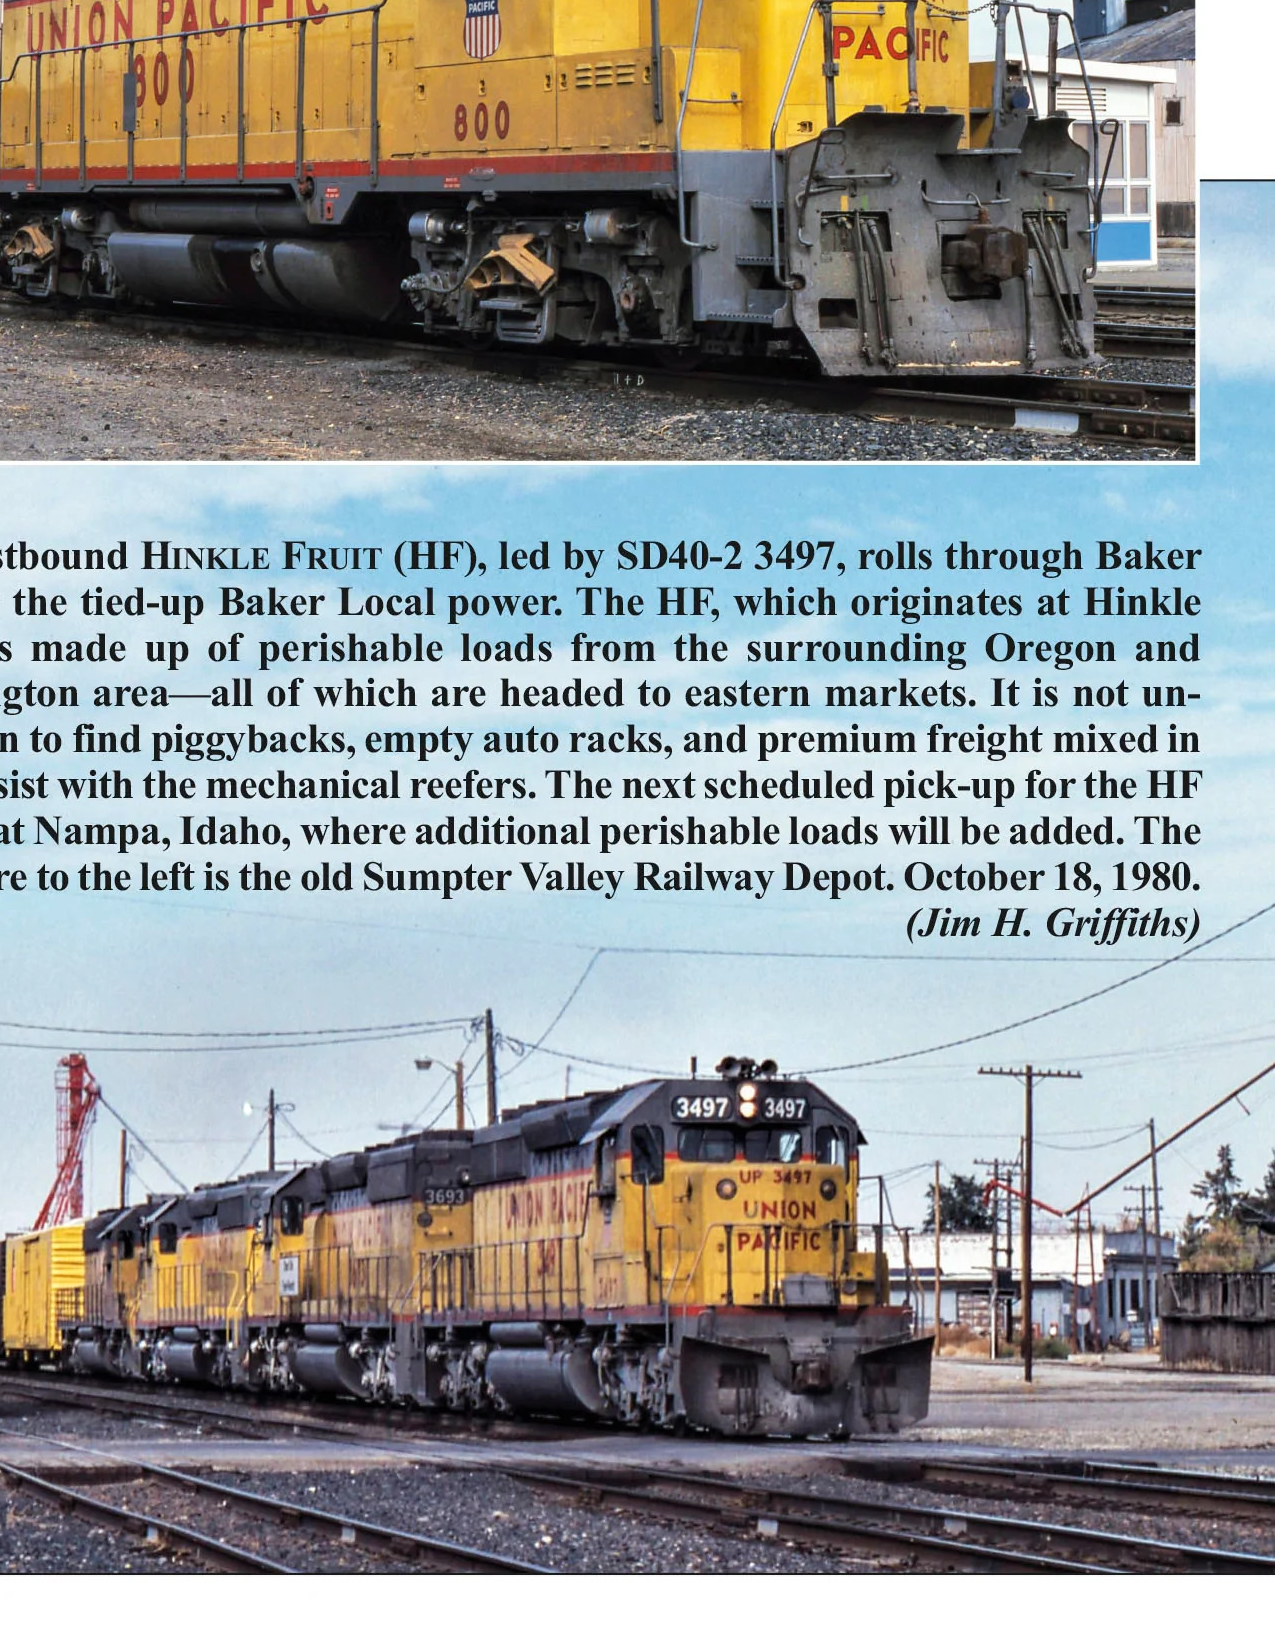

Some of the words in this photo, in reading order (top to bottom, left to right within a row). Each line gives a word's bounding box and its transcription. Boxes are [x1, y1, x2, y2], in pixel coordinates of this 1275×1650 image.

[468, 0, 496, 14] PACIFIC
[833, 25, 949, 64] PACIFIC
[132, 48, 195, 108] 800
[454, 100, 510, 142] 800
[676, 1097, 728, 1118] 3497
[765, 1097, 806, 1118] 3497
[739, 1169, 763, 1184] UP
[773, 1169, 812, 1184] 3497
[425, 1189, 465, 1204] 3693
[743, 1200, 817, 1219] UNION
